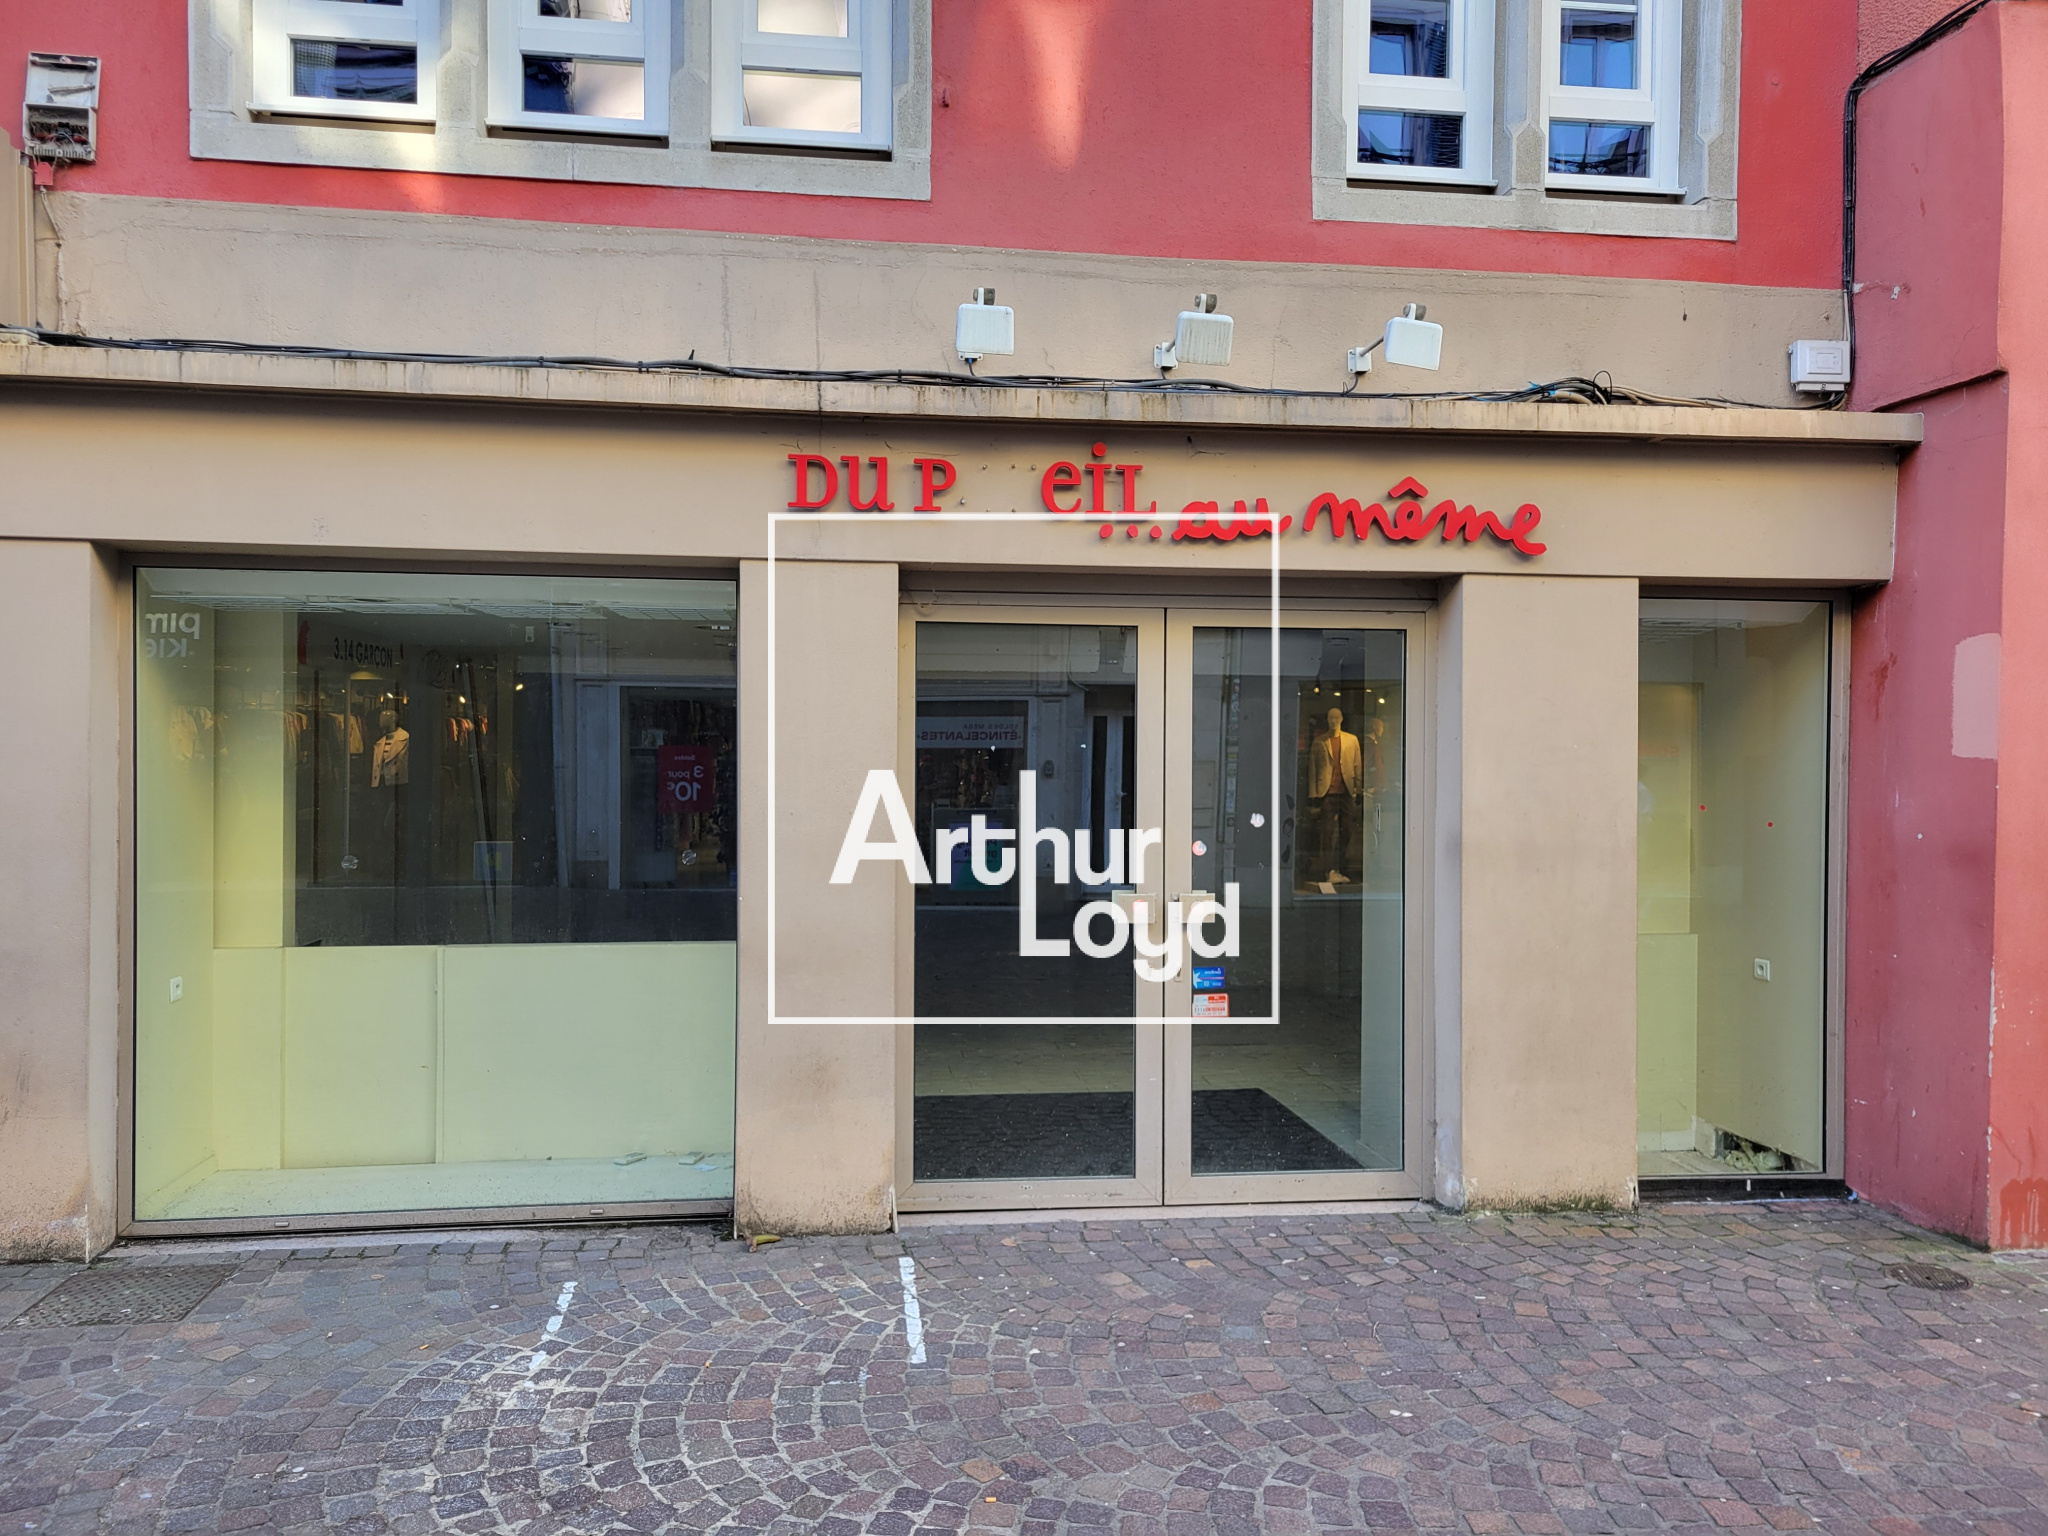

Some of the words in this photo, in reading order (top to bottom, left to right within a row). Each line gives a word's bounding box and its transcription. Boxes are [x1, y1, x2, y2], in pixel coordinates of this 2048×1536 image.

[1303, 475, 1548, 556] même
[333, 636, 354, 661] 3.14
[355, 641, 393, 669] GARÇON
